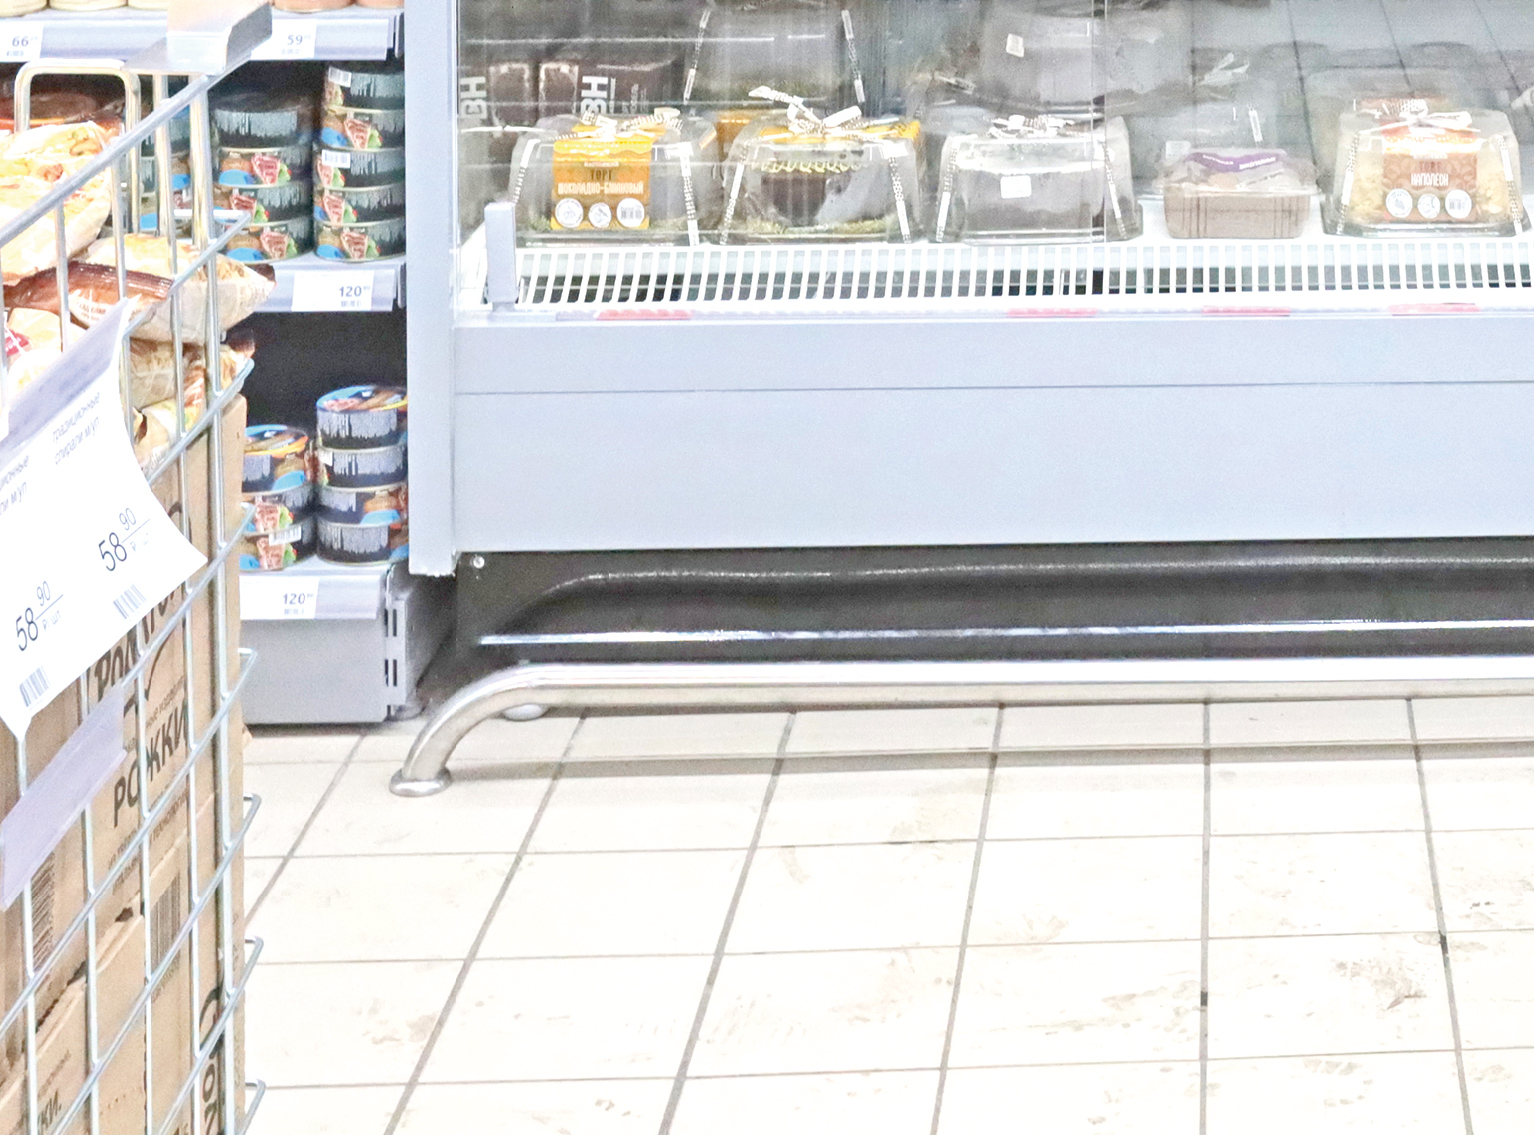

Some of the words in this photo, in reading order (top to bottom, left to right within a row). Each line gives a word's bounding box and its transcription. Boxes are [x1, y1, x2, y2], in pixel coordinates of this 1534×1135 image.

[12, 36, 29, 47] 66
[286, 34, 303, 46] 59
[590, 169, 613, 182] ТОРТ
[1410, 172, 1450, 187] НАПОЛЕОН
[338, 285, 362, 297] 120
[97, 532, 127, 572] 58
[118, 507, 137, 532] 90
[282, 593, 306, 605] 120
[15, 607, 39, 652] 58
[36, 580, 52, 607] 90
